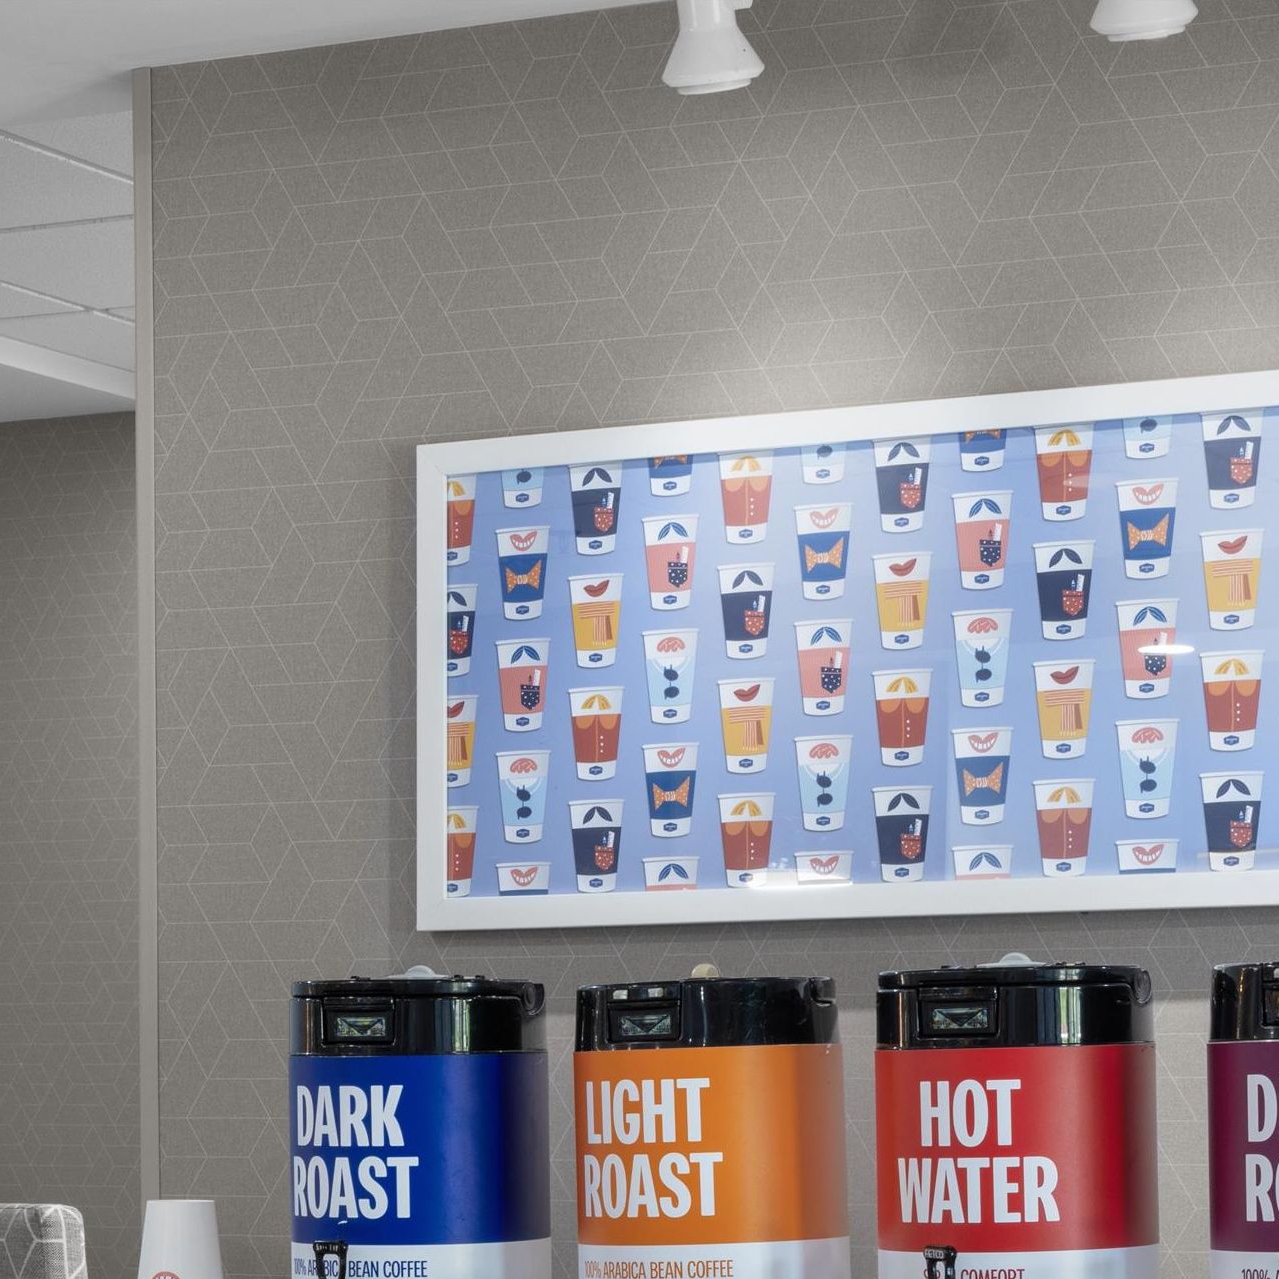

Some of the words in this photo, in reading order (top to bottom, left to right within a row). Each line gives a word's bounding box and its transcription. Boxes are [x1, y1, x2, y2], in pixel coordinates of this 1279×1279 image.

[296, 1084, 406, 1147] DARK
[585, 1077, 711, 1145] LIGHT
[919, 1078, 1022, 1148] HOT
[293, 1155, 420, 1220] ROAST
[583, 1151, 724, 1219] ROAST
[897, 1155, 1061, 1224] WATER
[308, 1259, 339, 1278] ARBIC
[348, 1260, 379, 1278] BEAN
[383, 1260, 428, 1279] COFFEE
[603, 1260, 646, 1279] ARABICA
[650, 1260, 684, 1279] BEAN
[687, 1259, 734, 1279] COFFEE
